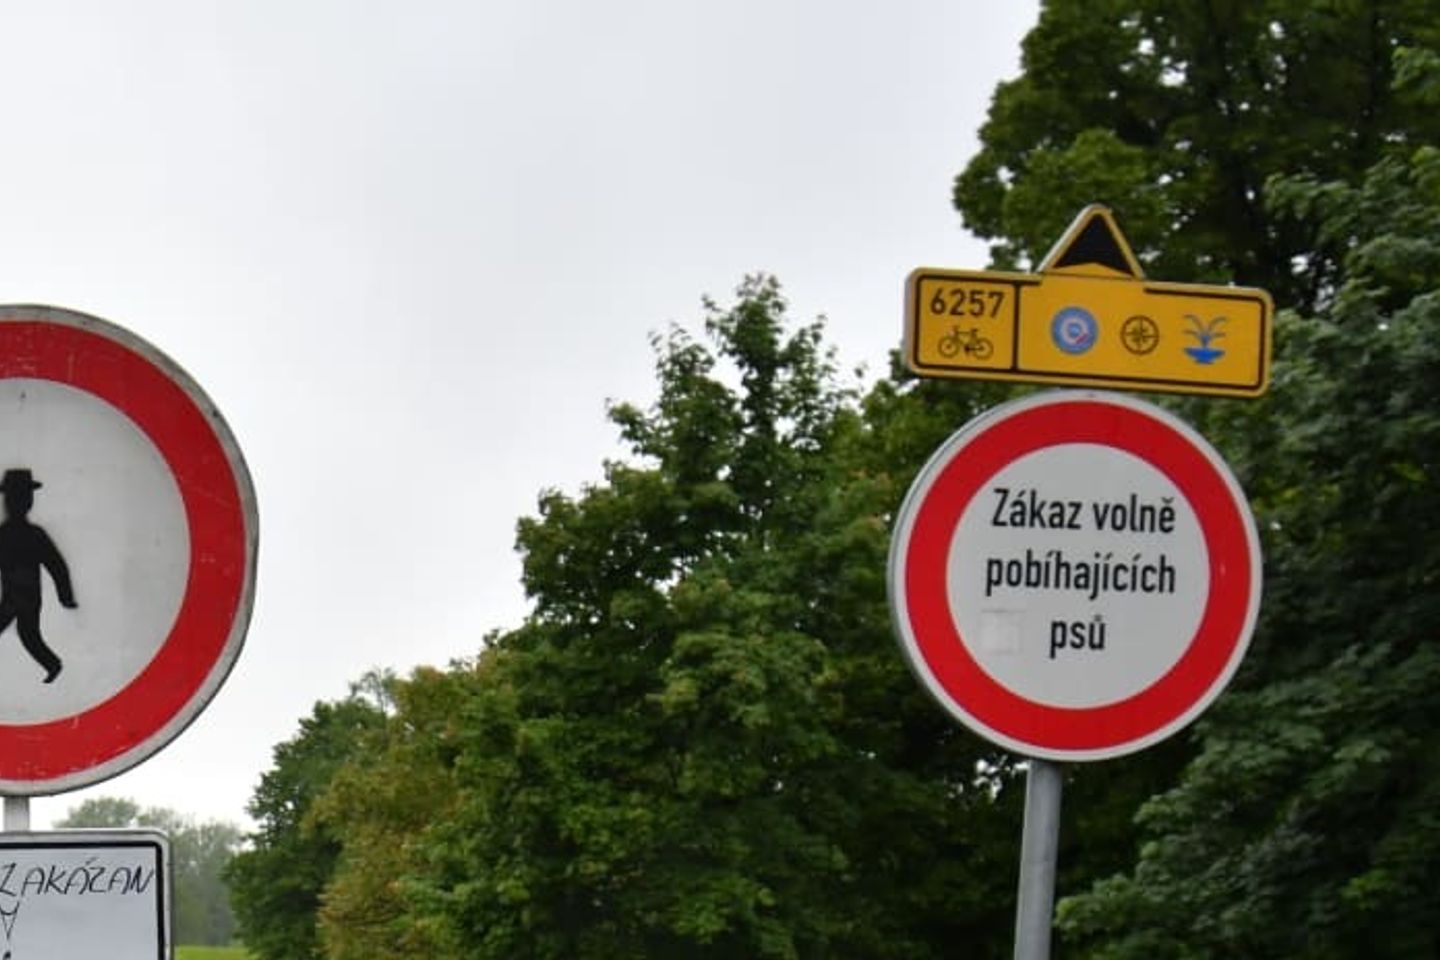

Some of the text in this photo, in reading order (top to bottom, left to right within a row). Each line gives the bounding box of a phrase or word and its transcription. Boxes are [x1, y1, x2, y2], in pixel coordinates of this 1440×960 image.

[930, 288, 1005, 319] 6257
[991, 488, 1177, 534] Zákaz volně
[985, 549, 1176, 600] pobíhajících
[1049, 614, 1106, 659] psů
